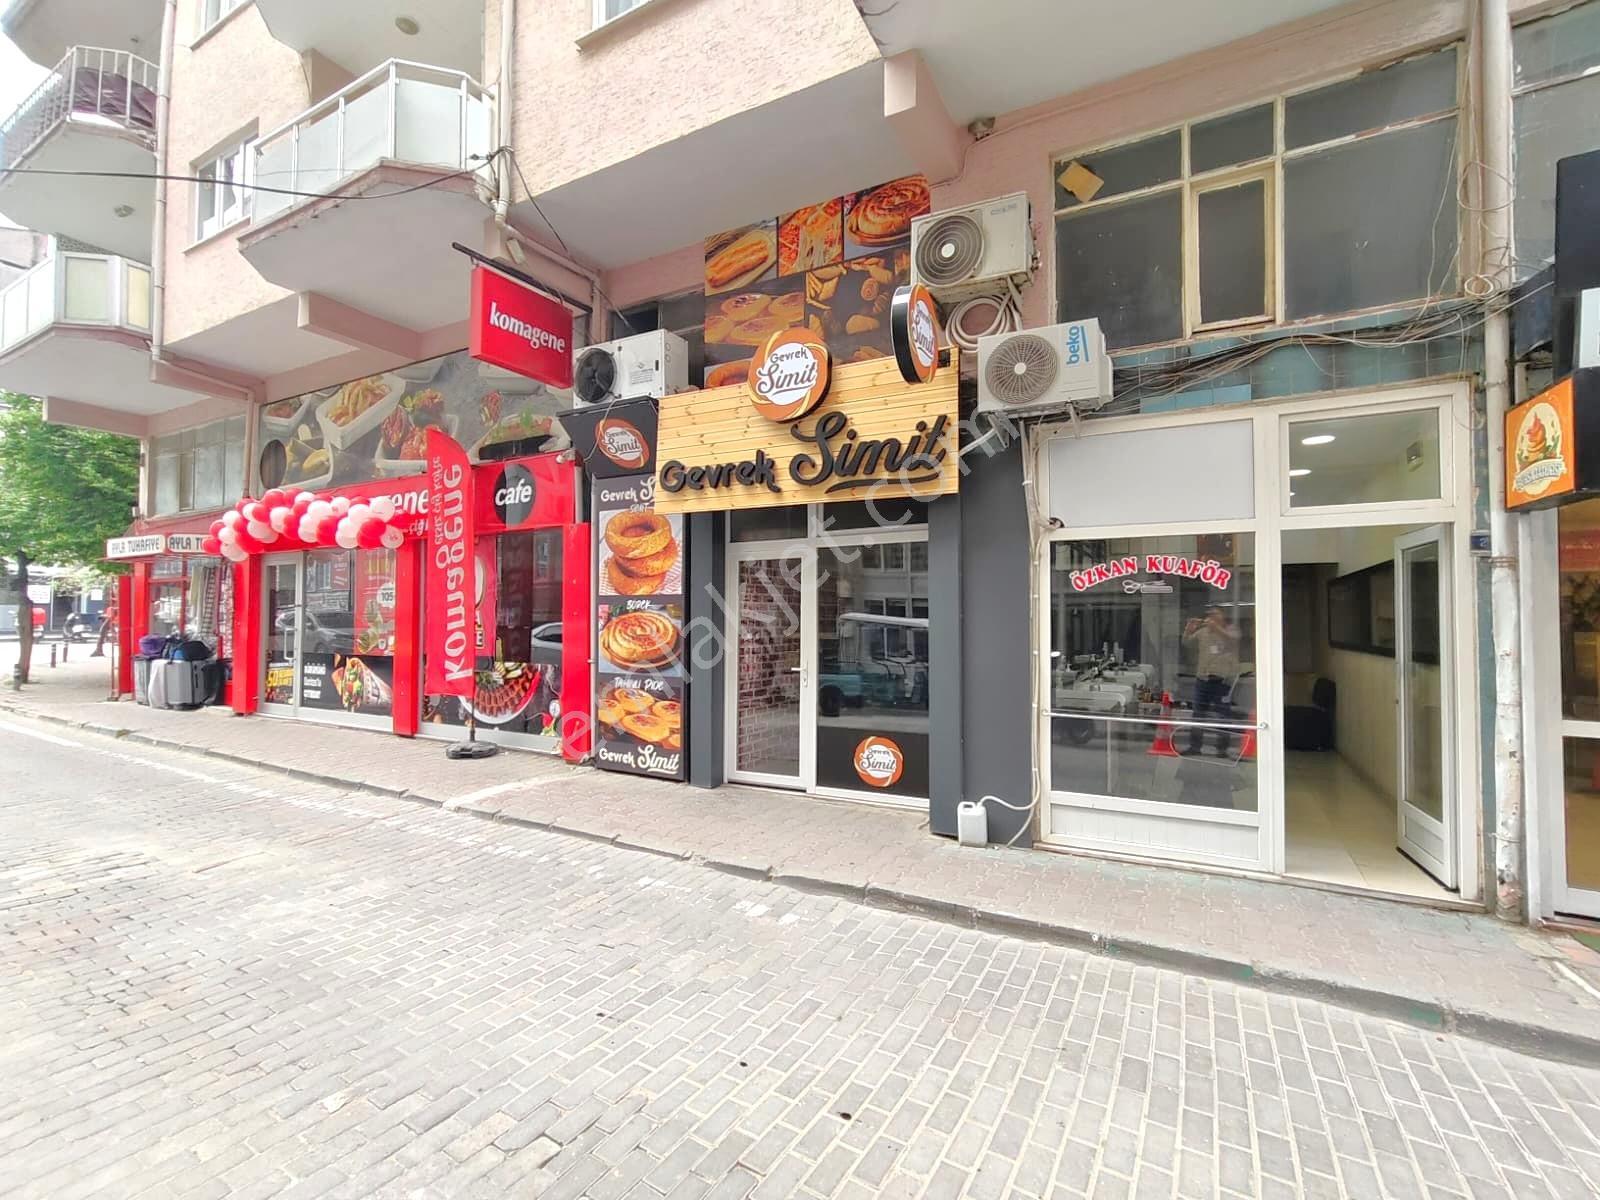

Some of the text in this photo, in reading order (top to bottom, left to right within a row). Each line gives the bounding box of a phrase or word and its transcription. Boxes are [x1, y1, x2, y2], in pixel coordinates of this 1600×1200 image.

[490, 301, 566, 353] komagene
[770, 346, 809, 364] Gevrek
[1065, 325, 1081, 365] beko
[757, 361, 817, 396] Simit
[604, 437, 642, 455] Simit
[659, 410, 949, 494] Gevrek Simit
[494, 478, 533, 506] cafe
[600, 487, 639, 503] Gevrek
[169, 536, 192, 550] AYLA
[1069, 554, 1232, 592] ÖZKAN KUAFÖR
[380, 591, 394, 602] 105
[599, 744, 680, 775] Gevrek Simit
[860, 752, 897, 773] Simit
